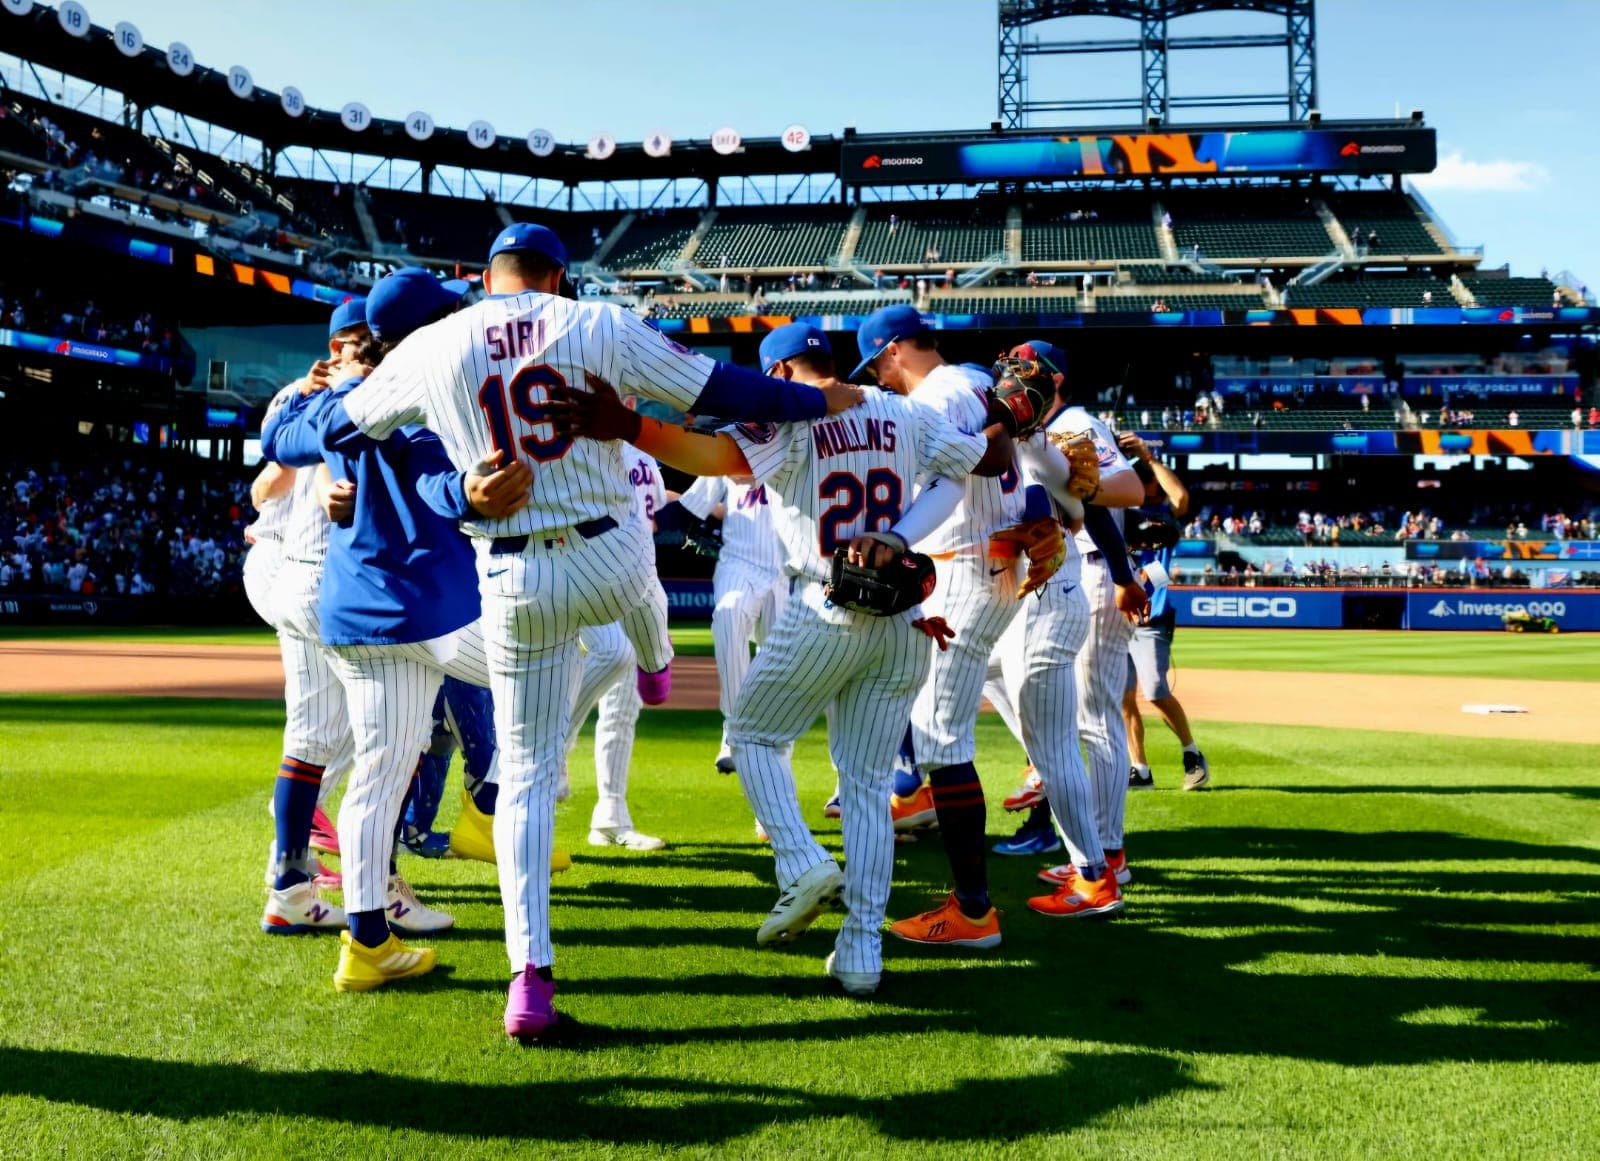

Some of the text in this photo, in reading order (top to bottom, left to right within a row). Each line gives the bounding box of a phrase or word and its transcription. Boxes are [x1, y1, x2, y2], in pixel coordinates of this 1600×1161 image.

[66, 9, 82, 28] 18
[121, 31, 135, 48] 16
[171, 51, 189, 67] 24
[234, 73, 247, 89] 17
[286, 93, 300, 110] 36
[349, 110, 363, 124] 31
[412, 118, 426, 133] 41
[475, 128, 488, 141] 14
[533, 135, 549, 149] 37
[787, 131, 804, 144] 42
[486, 319, 546, 361] SIRI
[478, 363, 575, 470] 19
[818, 466, 902, 557] 28
[1191, 597, 1297, 617] GEICO
